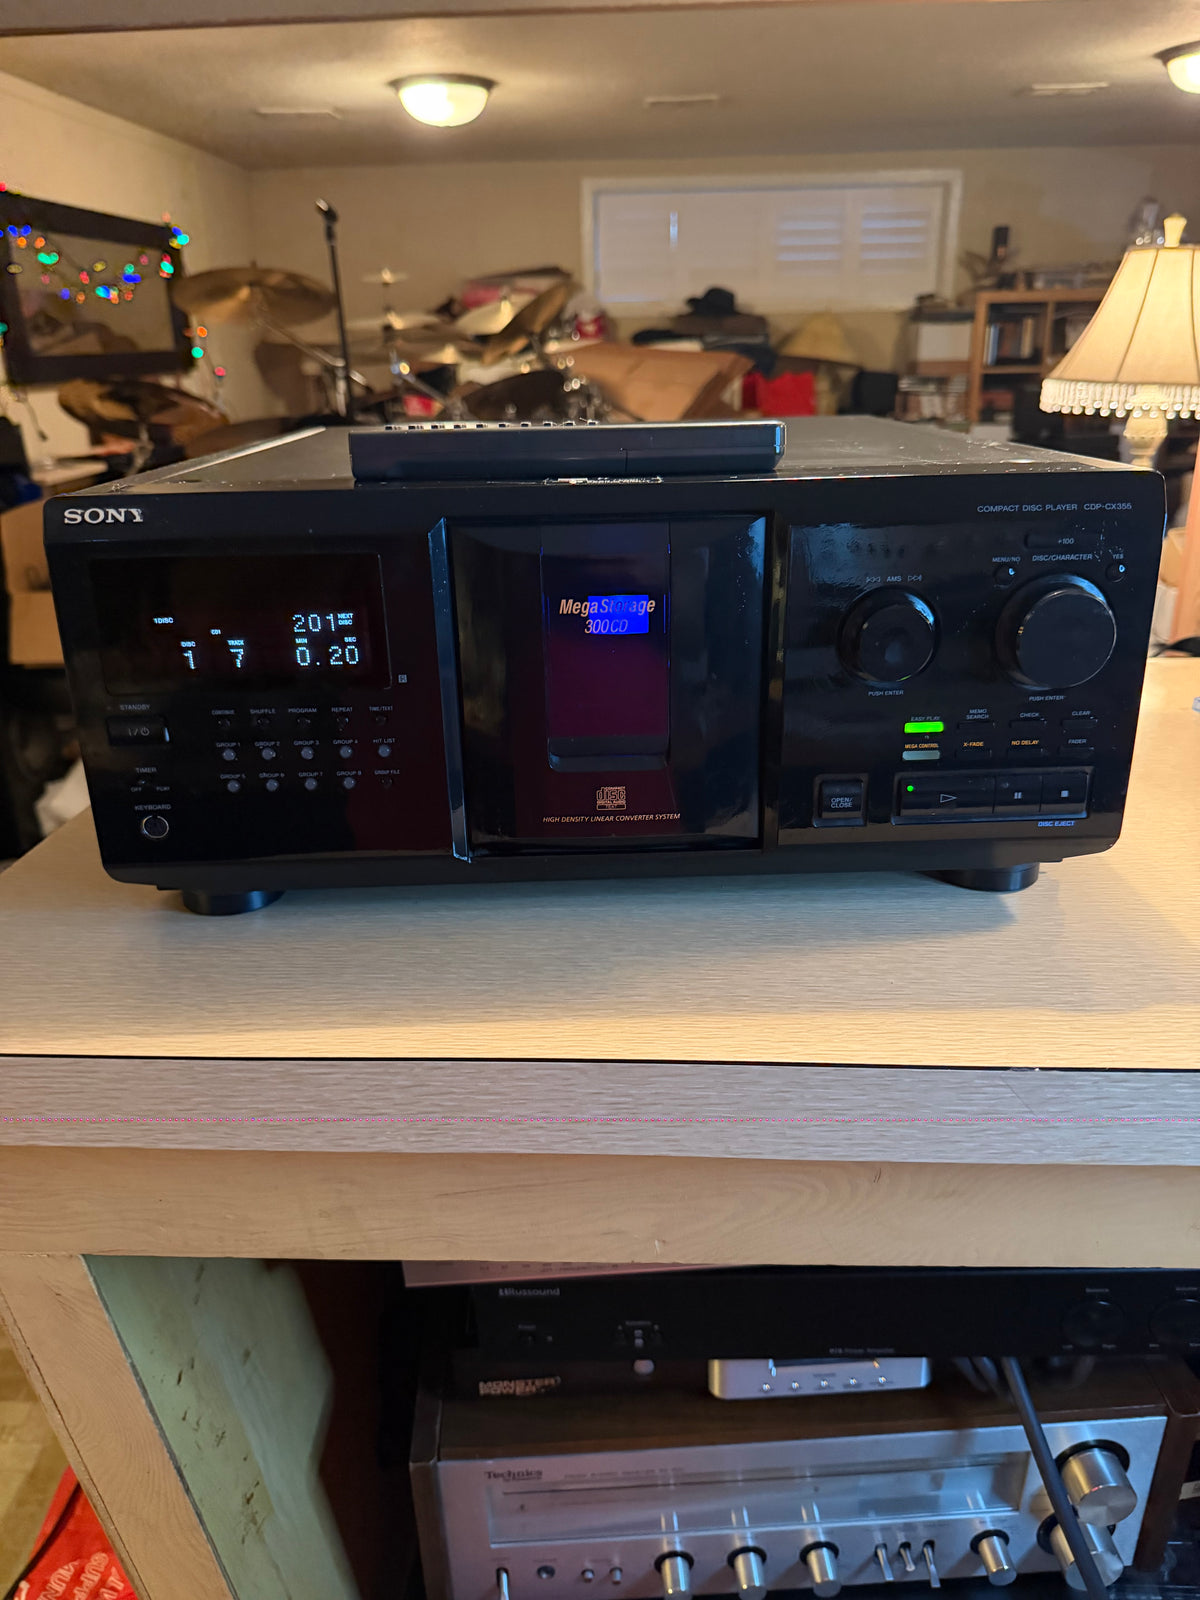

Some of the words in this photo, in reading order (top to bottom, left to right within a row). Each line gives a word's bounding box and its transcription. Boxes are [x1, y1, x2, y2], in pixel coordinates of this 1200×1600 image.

[977, 504, 1020, 513] COMPACT
[1022, 503, 1043, 512] DISC
[1045, 503, 1078, 512] PLAYER
[1083, 502, 1133, 511] CDP-CX355
[63, 507, 145, 525] SONY
[1031, 553, 1093, 562] DISC/CHARACTER
[292, 613, 335, 632] 201
[183, 650, 196, 670] 1
[229, 648, 244, 668] 7
[119, 704, 151, 712] STANDBY
[288, 706, 318, 714] PROGRAM
[216, 741, 235, 749] GROUP
[254, 740, 275, 748] GROUP
[293, 739, 314, 747] GROUP
[332, 738, 353, 746] GROUP
[258, 771, 280, 779] GROUP
[336, 769, 357, 777] GROUP
[561, 815, 589, 823] DENSITY
[615, 814, 654, 822] CONVERTER
[655, 813, 681, 821] SYSTEM
[485, 1469, 543, 1481] Technics
